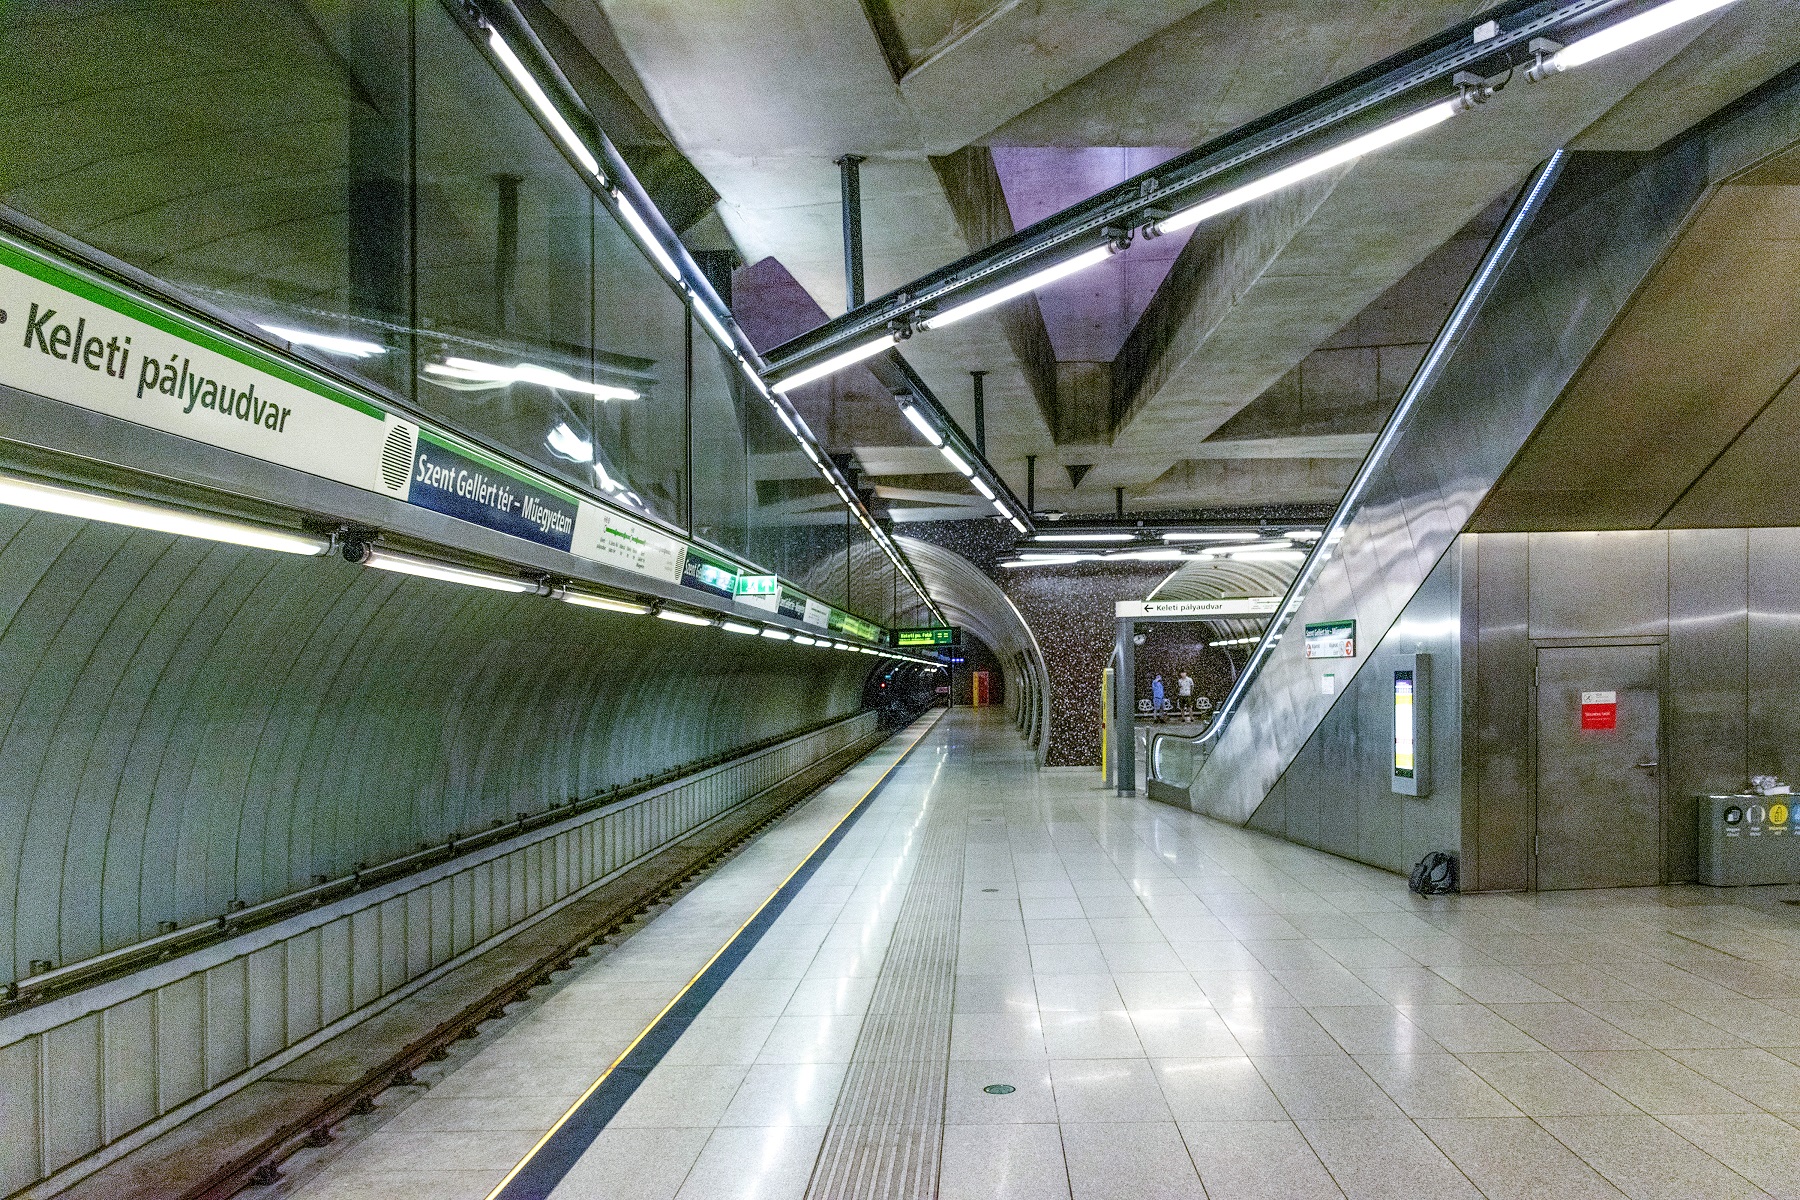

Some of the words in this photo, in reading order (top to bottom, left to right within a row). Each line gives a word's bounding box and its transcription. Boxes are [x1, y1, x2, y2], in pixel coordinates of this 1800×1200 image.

[23, 302, 131, 380] Keleti
[136, 353, 291, 433] pályaudvar
[416, 454, 456, 493] Szent
[456, 470, 497, 507] Gellért
[497, 486, 514, 513] tér
[521, 495, 572, 534] Műegyetem
[1180, 603, 1222, 612] pályaudvar
